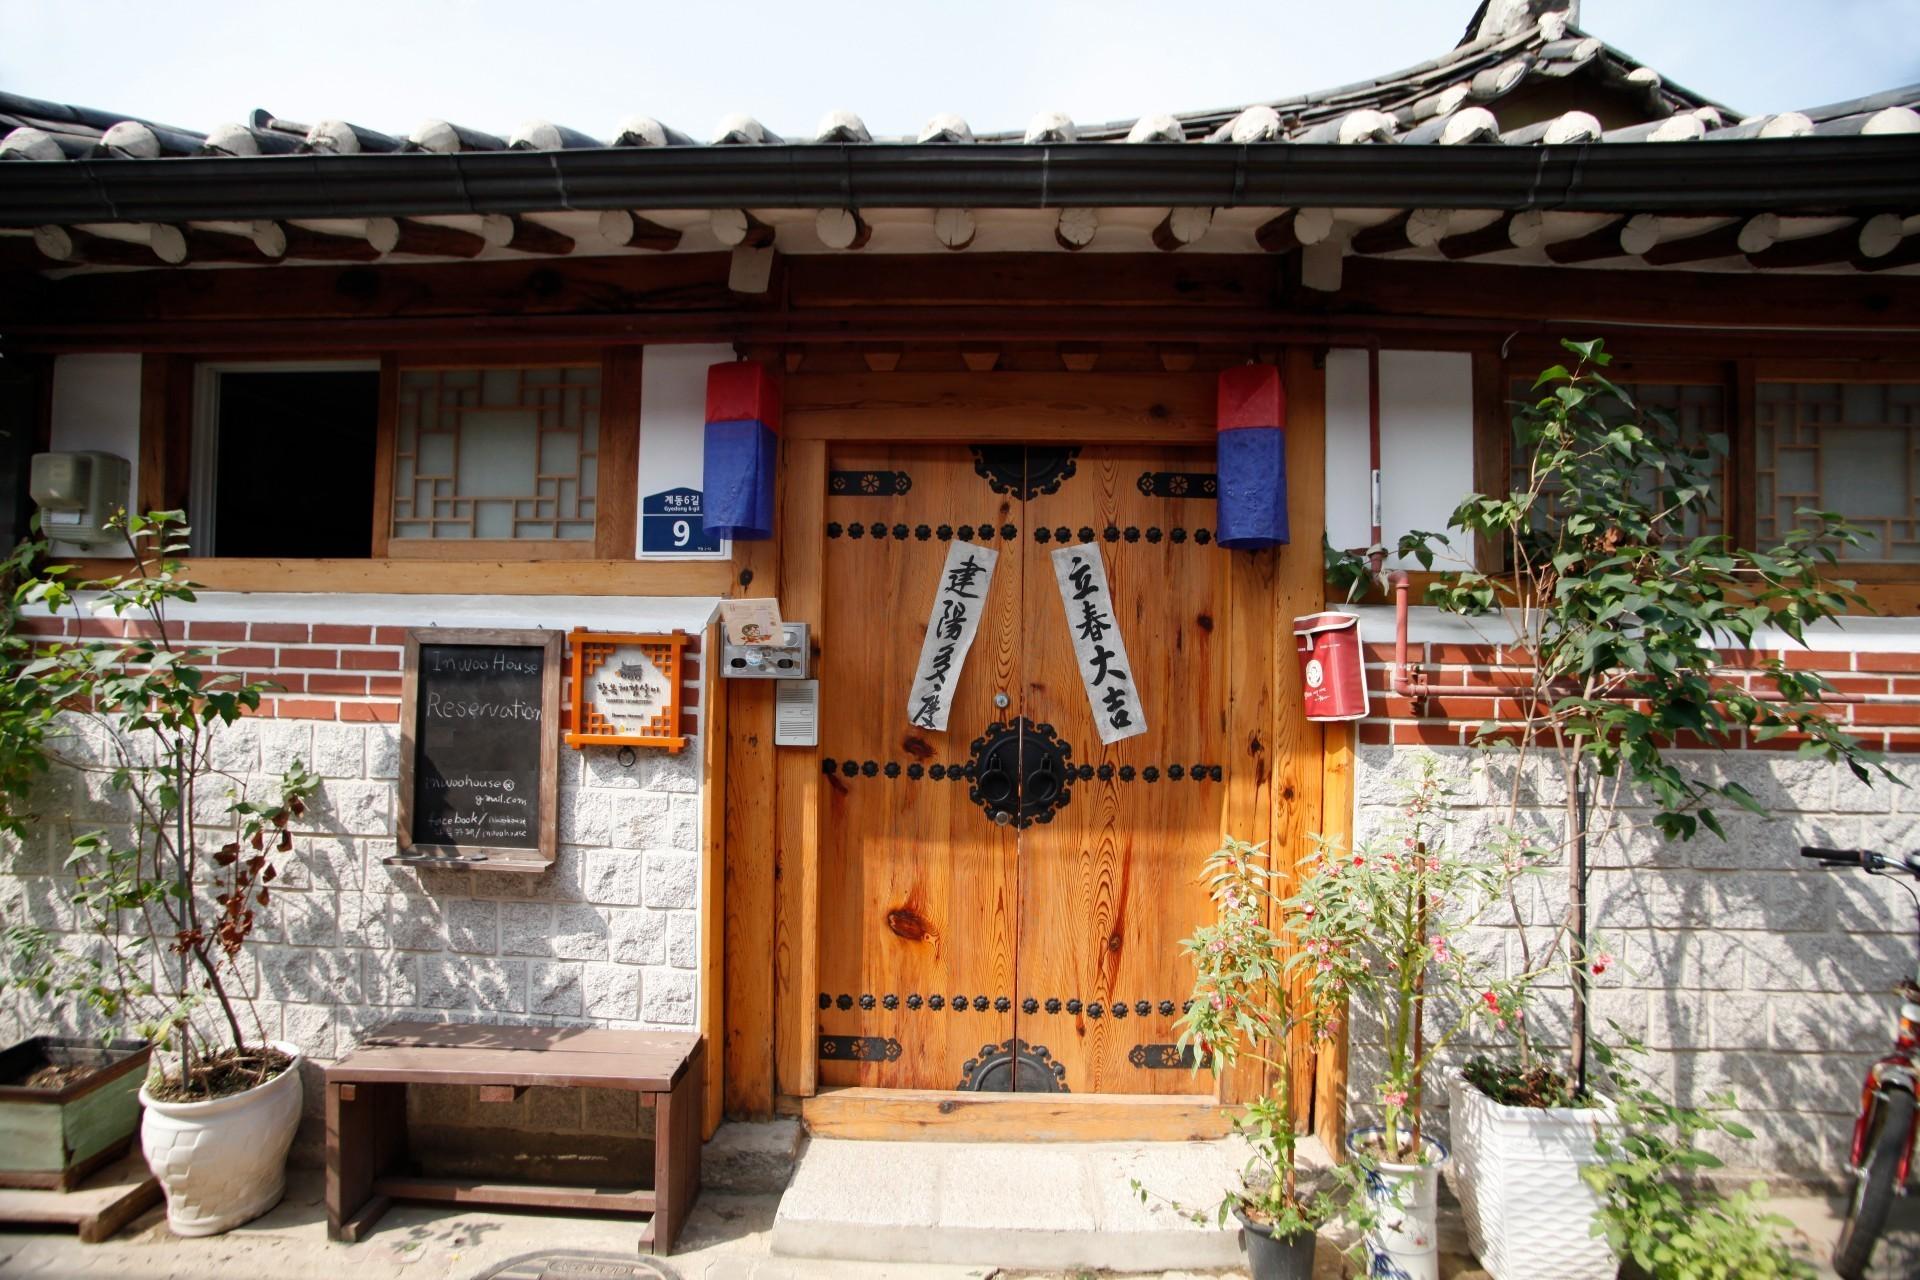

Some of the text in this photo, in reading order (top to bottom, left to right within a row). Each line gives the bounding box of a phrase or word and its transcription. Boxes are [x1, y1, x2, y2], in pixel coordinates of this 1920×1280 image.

[664, 495, 699, 506] 계동6길
[673, 520, 690, 547] 9
[1068, 556, 1132, 729] 立春大吉
[493, 652, 538, 674] House
[427, 690, 542, 721] Reservation
[475, 794, 527, 806] gmail.com
